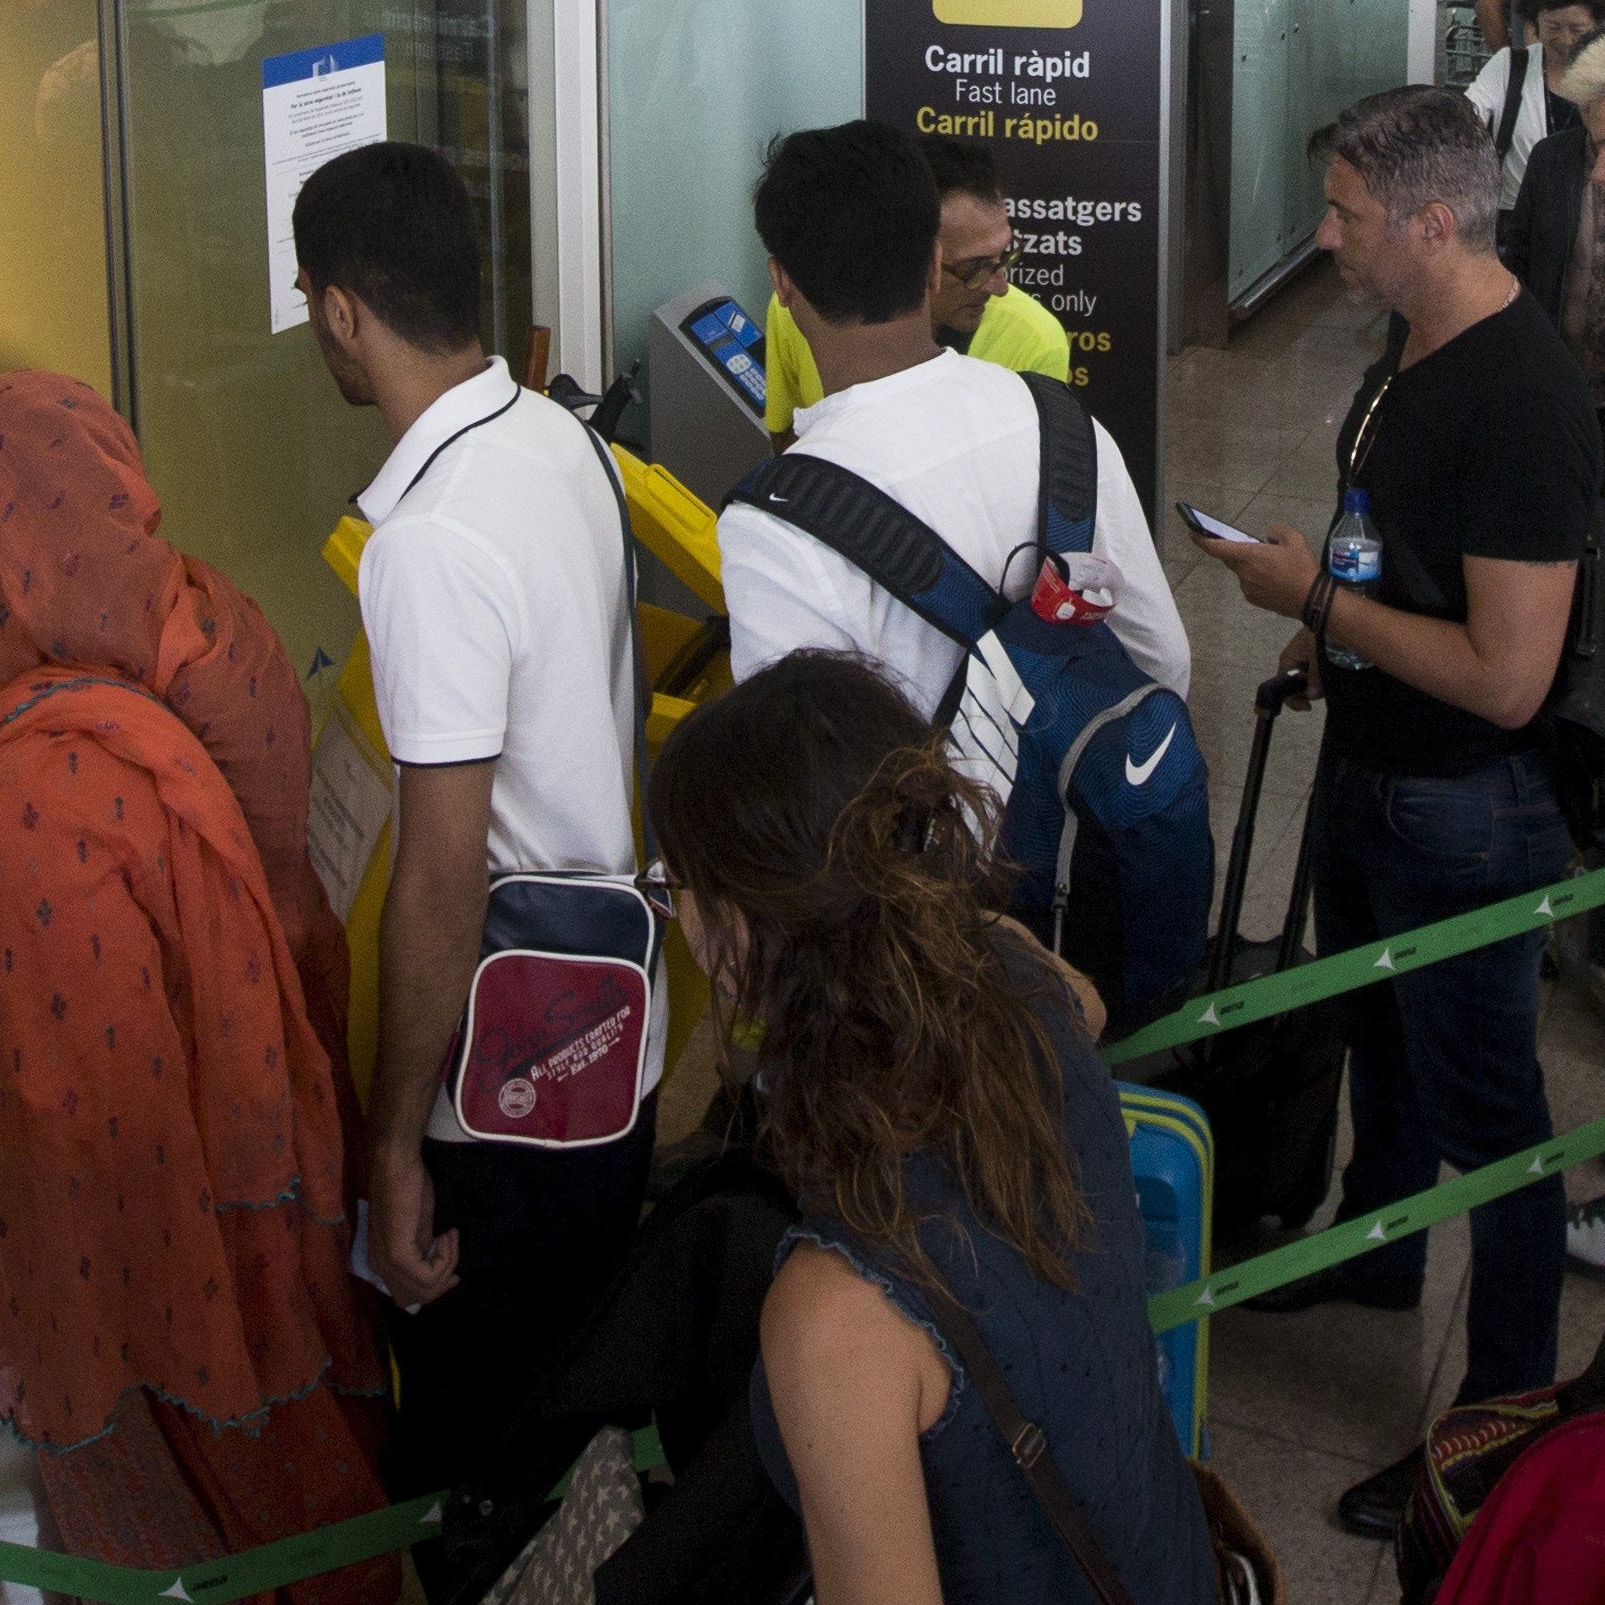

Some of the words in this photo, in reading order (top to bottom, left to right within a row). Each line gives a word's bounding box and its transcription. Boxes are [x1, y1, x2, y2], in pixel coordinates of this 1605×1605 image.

[924, 45, 1004, 76] Carril
[1014, 46, 1091, 80] ràpid
[955, 79, 1003, 105] Fast
[1010, 81, 1056, 106] lane
[916, 107, 994, 138] Carril
[1005, 107, 1098, 144] rápido
[1004, 196, 1142, 227] assatgers
[1051, 290, 1097, 317] only
[191, 1574, 229, 1592] aena
